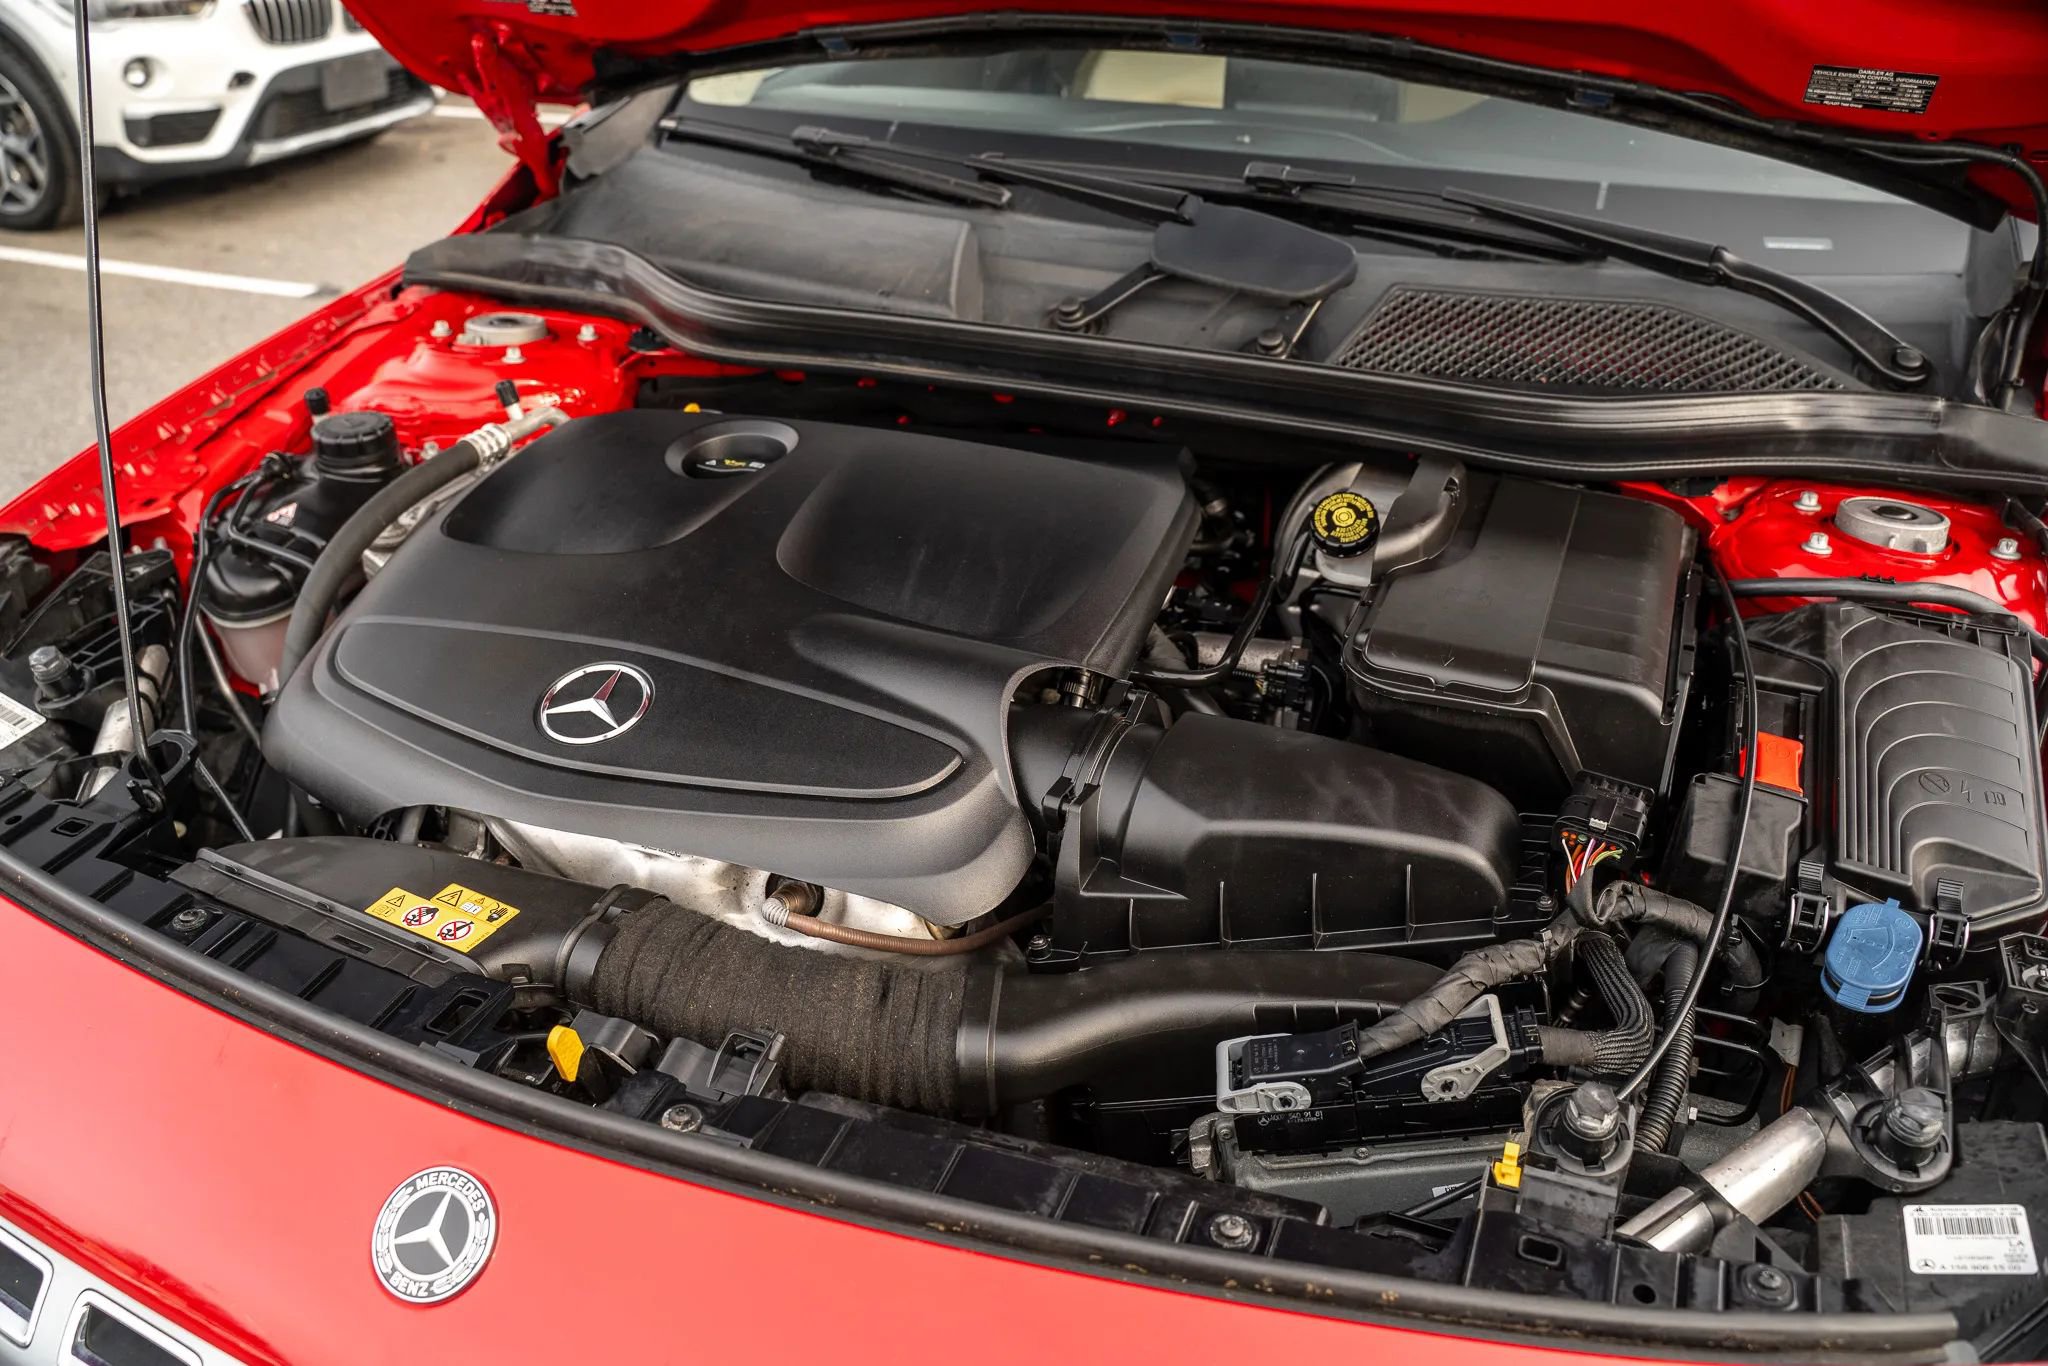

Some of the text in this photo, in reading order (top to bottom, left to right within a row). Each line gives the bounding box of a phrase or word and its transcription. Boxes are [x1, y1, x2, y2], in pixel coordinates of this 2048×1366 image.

[1838, 72, 1866, 80] EMISSION
[1896, 77, 1937, 86] INFORMATION
[415, 1171, 486, 1212] MERCEDES
[389, 1270, 429, 1297] BENZ
